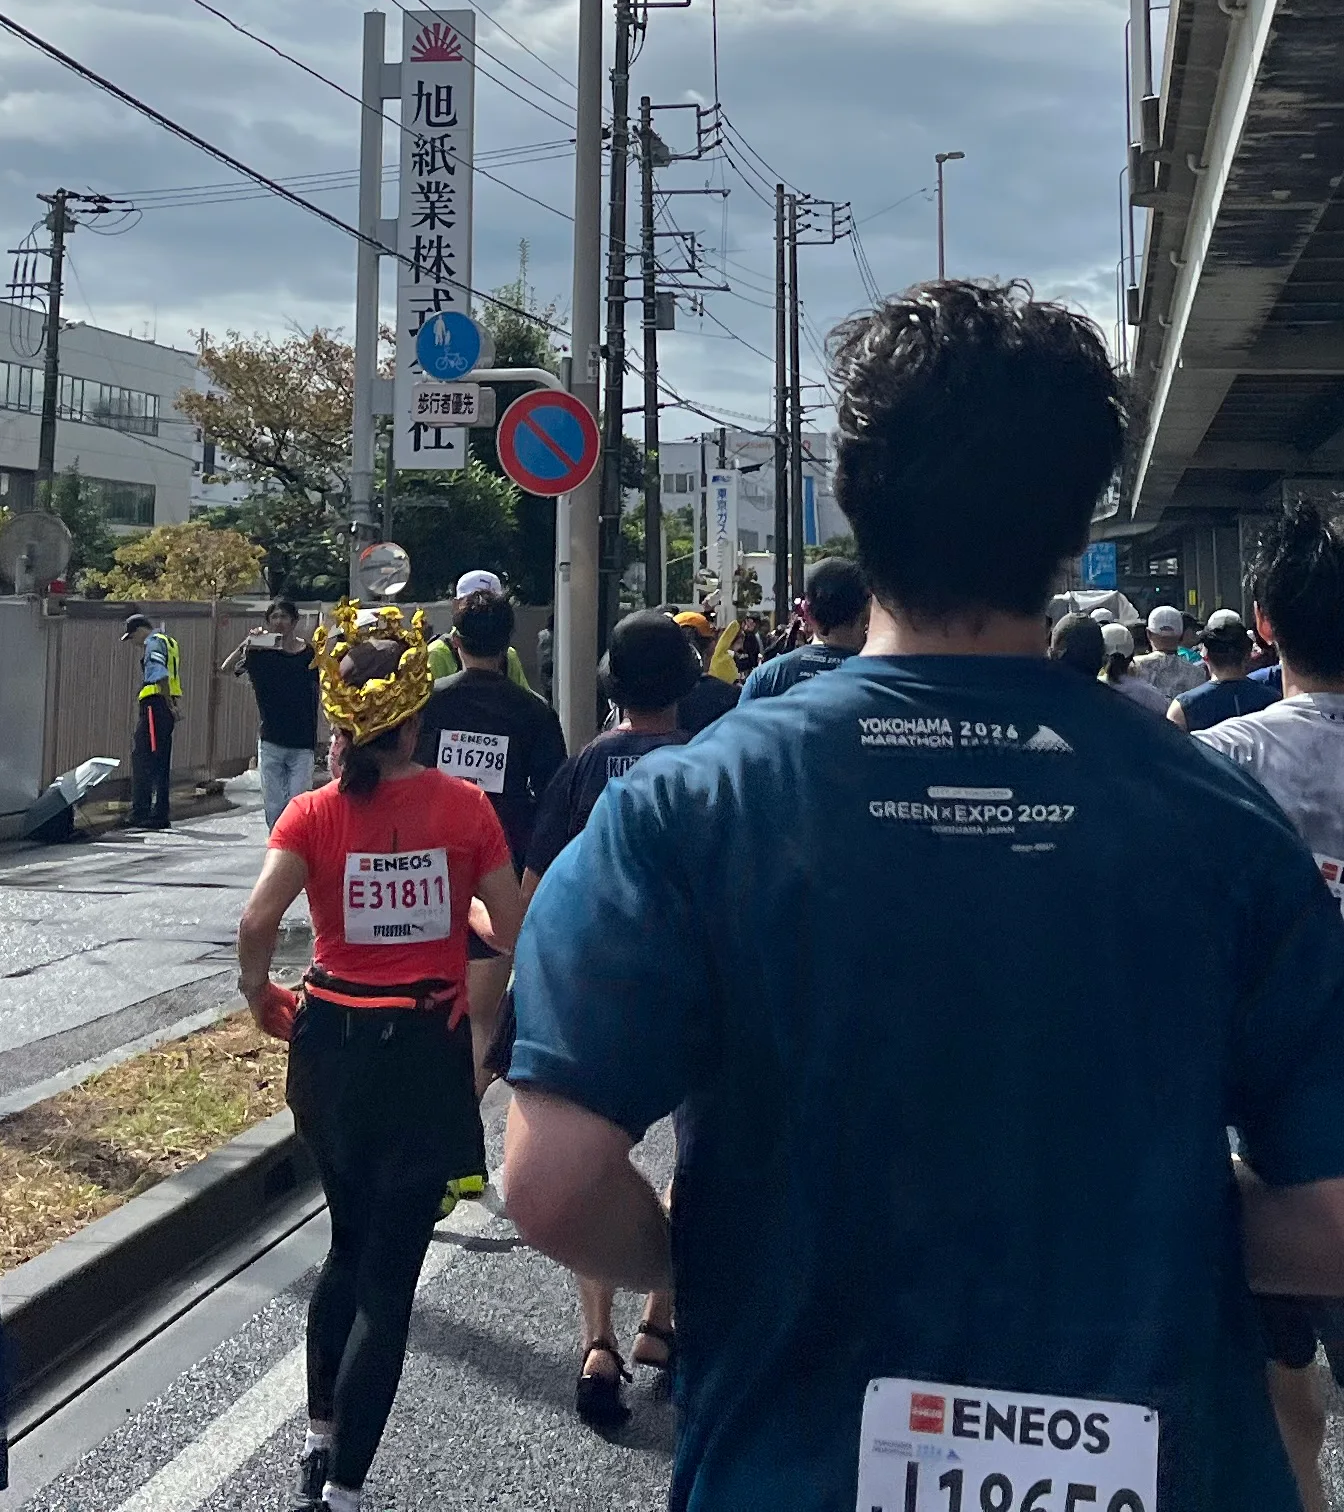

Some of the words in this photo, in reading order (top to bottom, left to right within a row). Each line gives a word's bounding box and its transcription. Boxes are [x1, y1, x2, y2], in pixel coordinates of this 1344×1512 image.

[408, 80, 458, 452] 旭紙業株式社
[418, 392, 474, 414] 歩行者優先
[858, 717, 953, 734] YOKOHAMA
[461, 733, 499, 746] ENEOS
[861, 734, 954, 748] MARATHON
[442, 746, 505, 770] G16798
[1017, 804, 1076, 823] 2027
[373, 853, 432, 872] ENEOS
[349, 876, 444, 909] E31811
[952, 1397, 1111, 1455] ENEOS
